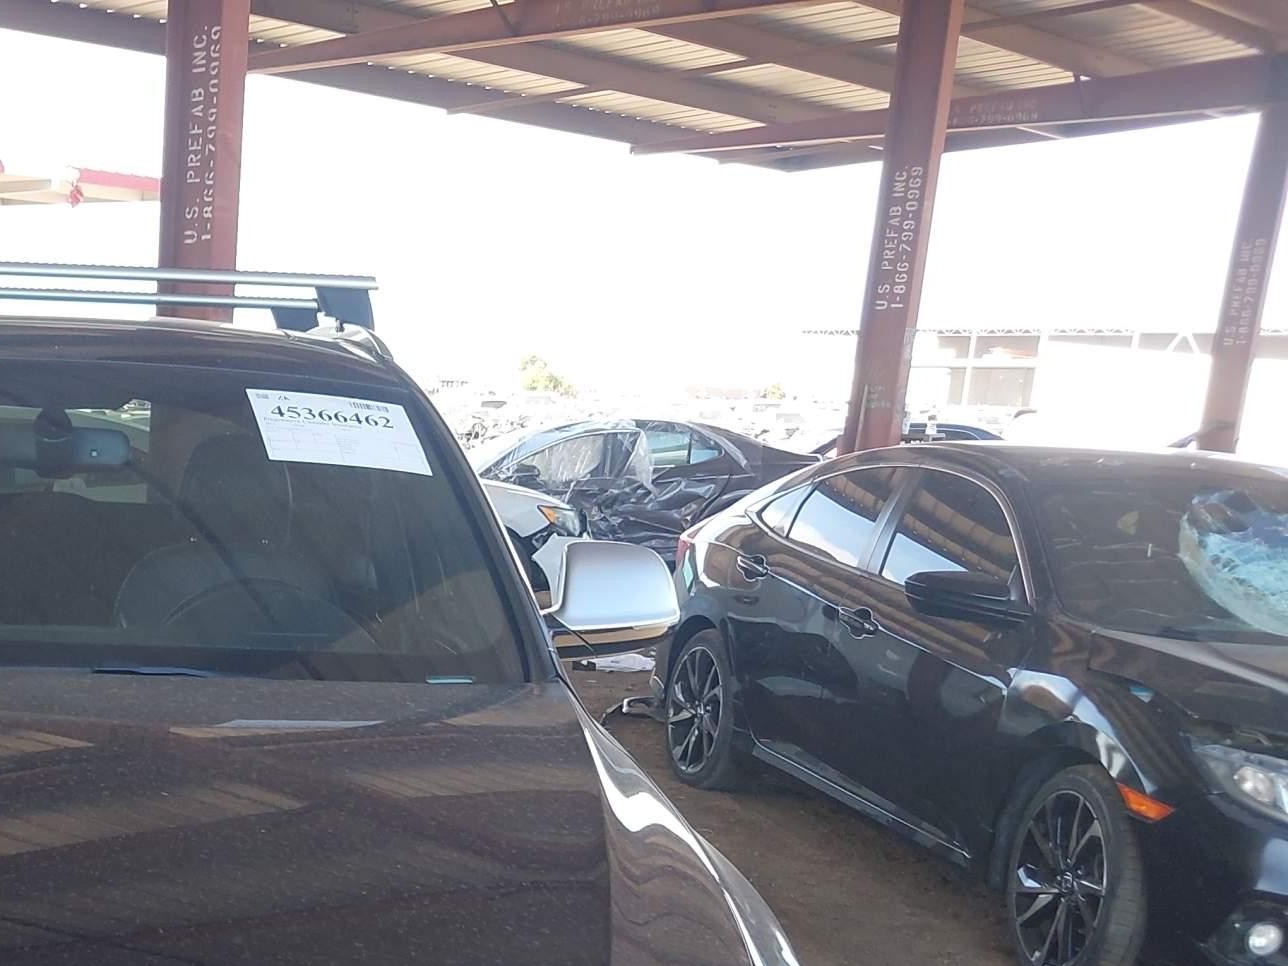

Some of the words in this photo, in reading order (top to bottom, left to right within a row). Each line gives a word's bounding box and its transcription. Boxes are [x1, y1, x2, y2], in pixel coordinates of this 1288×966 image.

[193, 26, 209, 72] INC.
[187, 88, 205, 183] PREFAB
[185, 198, 199, 243] U.S.
[881, 206, 902, 270] PREFAB
[891, 166, 924, 308] 1-866-799-0969
[270, 404, 395, 429] 45366462
